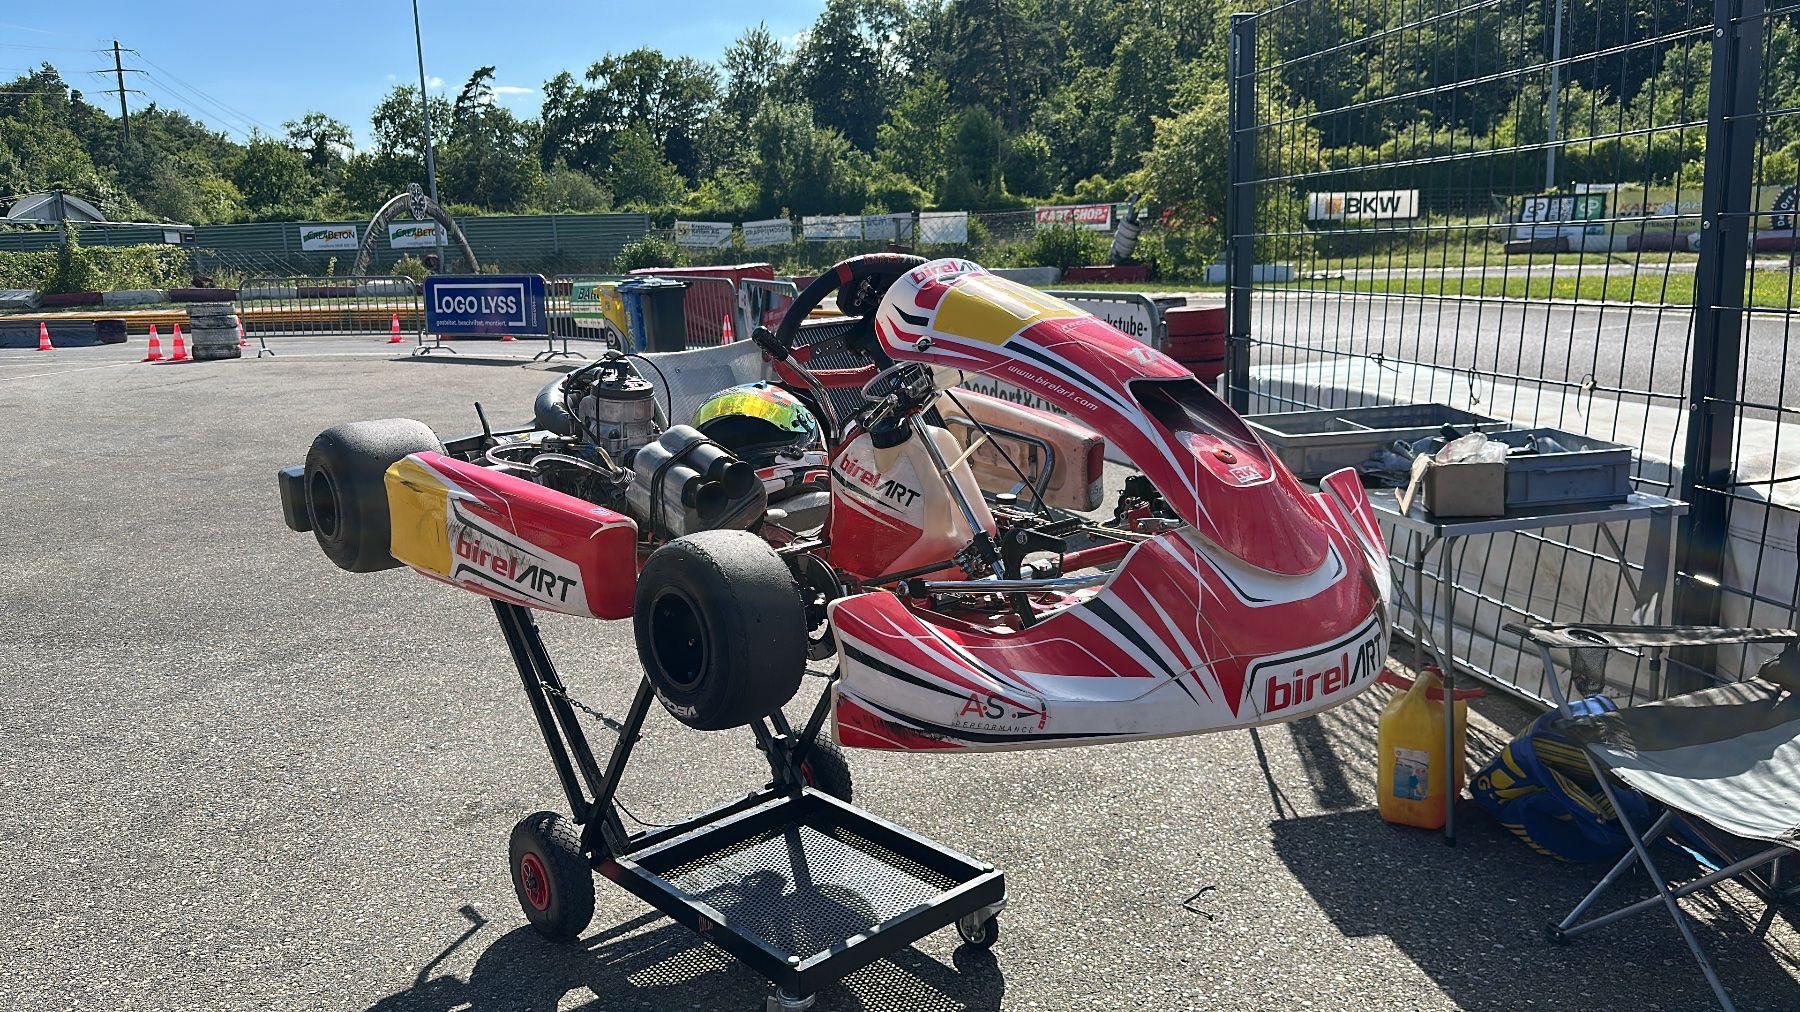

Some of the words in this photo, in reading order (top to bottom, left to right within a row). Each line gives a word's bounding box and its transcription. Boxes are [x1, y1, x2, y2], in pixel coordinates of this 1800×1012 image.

[1346, 196, 1401, 214] BKW
[435, 295, 478, 314] LOGO
[481, 295, 517, 314] LYSS
[1006, 364, 1099, 412] www.birelart.com
[1263, 631, 1382, 714] birelART
